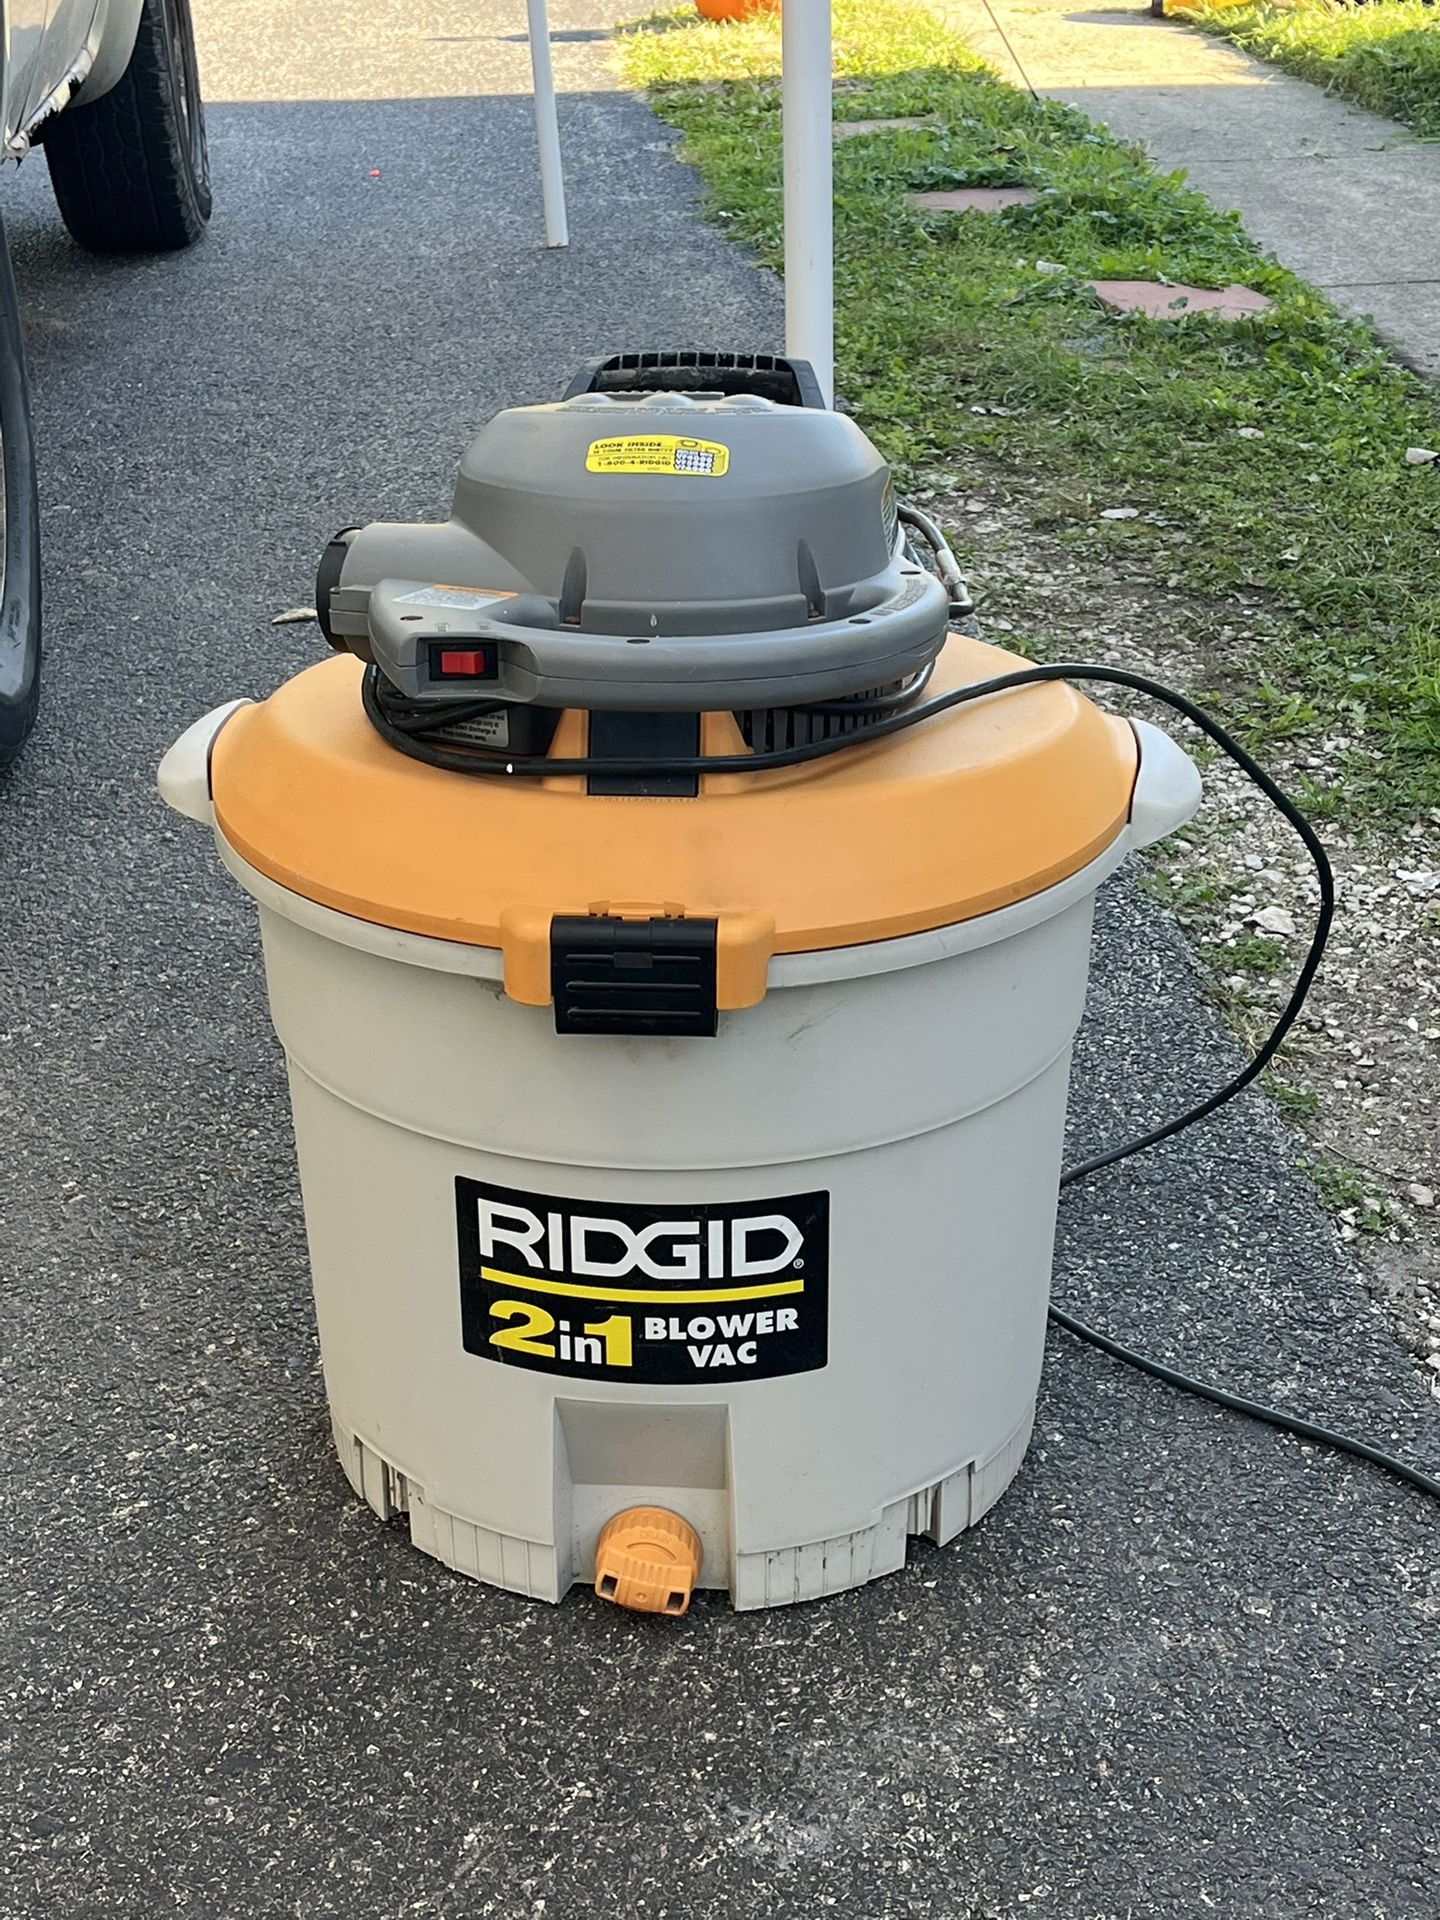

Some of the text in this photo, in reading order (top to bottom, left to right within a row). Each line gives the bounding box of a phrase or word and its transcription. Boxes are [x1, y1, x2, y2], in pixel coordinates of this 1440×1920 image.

[594, 442, 624, 450] LOOK
[644, 1308, 799, 1340] BLOWER
[687, 1341, 757, 1368] VAC
[639, 1529, 673, 1546] DRAIN
